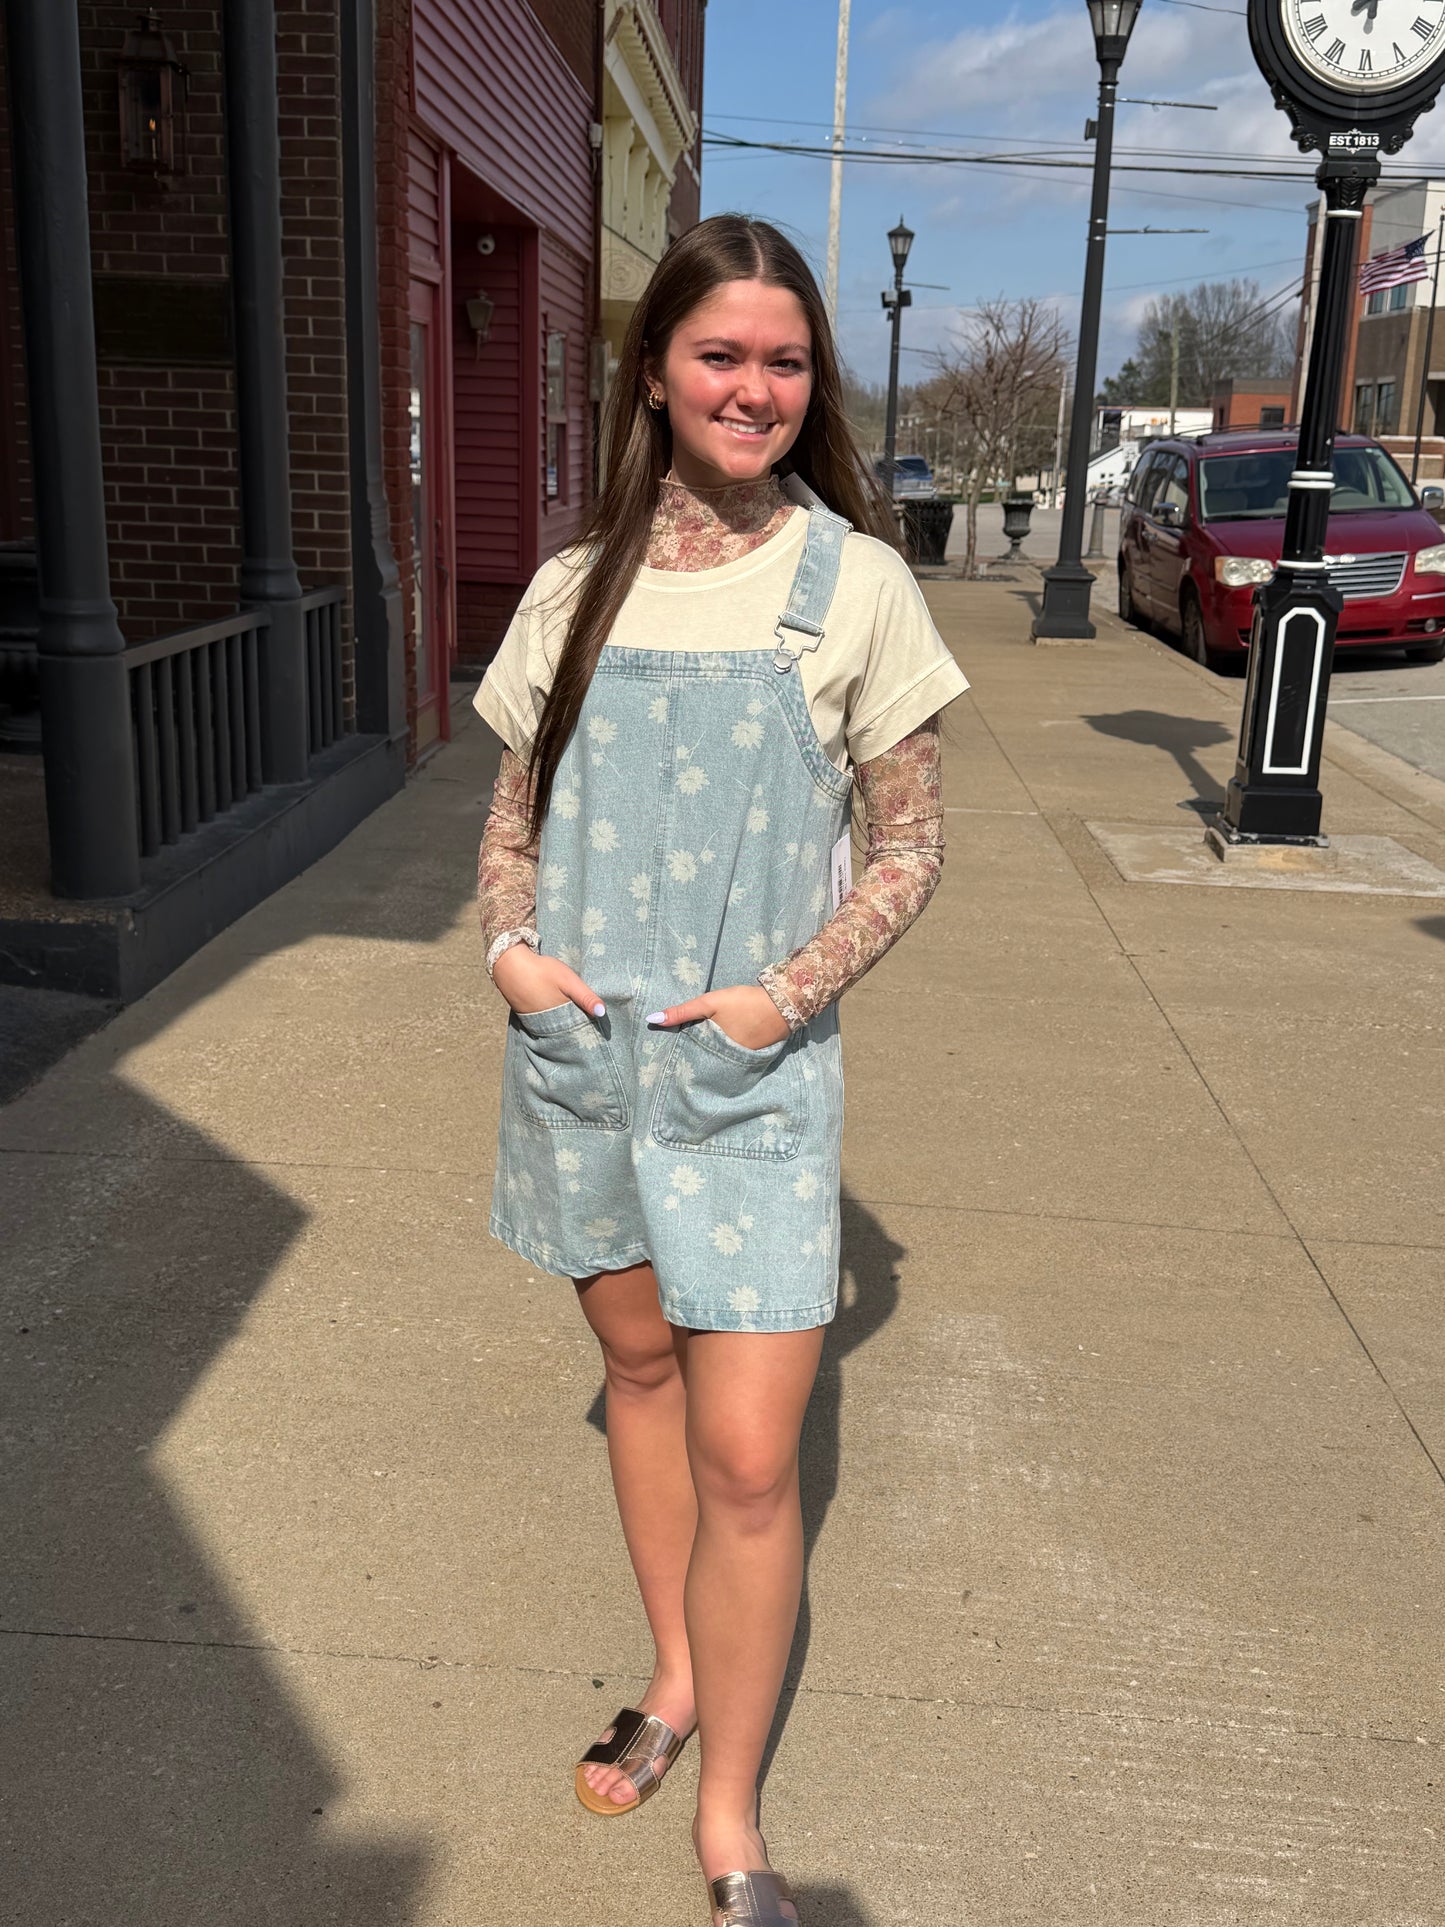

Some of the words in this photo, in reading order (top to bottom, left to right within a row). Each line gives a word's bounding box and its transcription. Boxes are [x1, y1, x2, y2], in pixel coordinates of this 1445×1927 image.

[1359, 49, 1373, 71] VI
[1392, 42, 1407, 63] V
[1353, 136, 1380, 146] 1813
